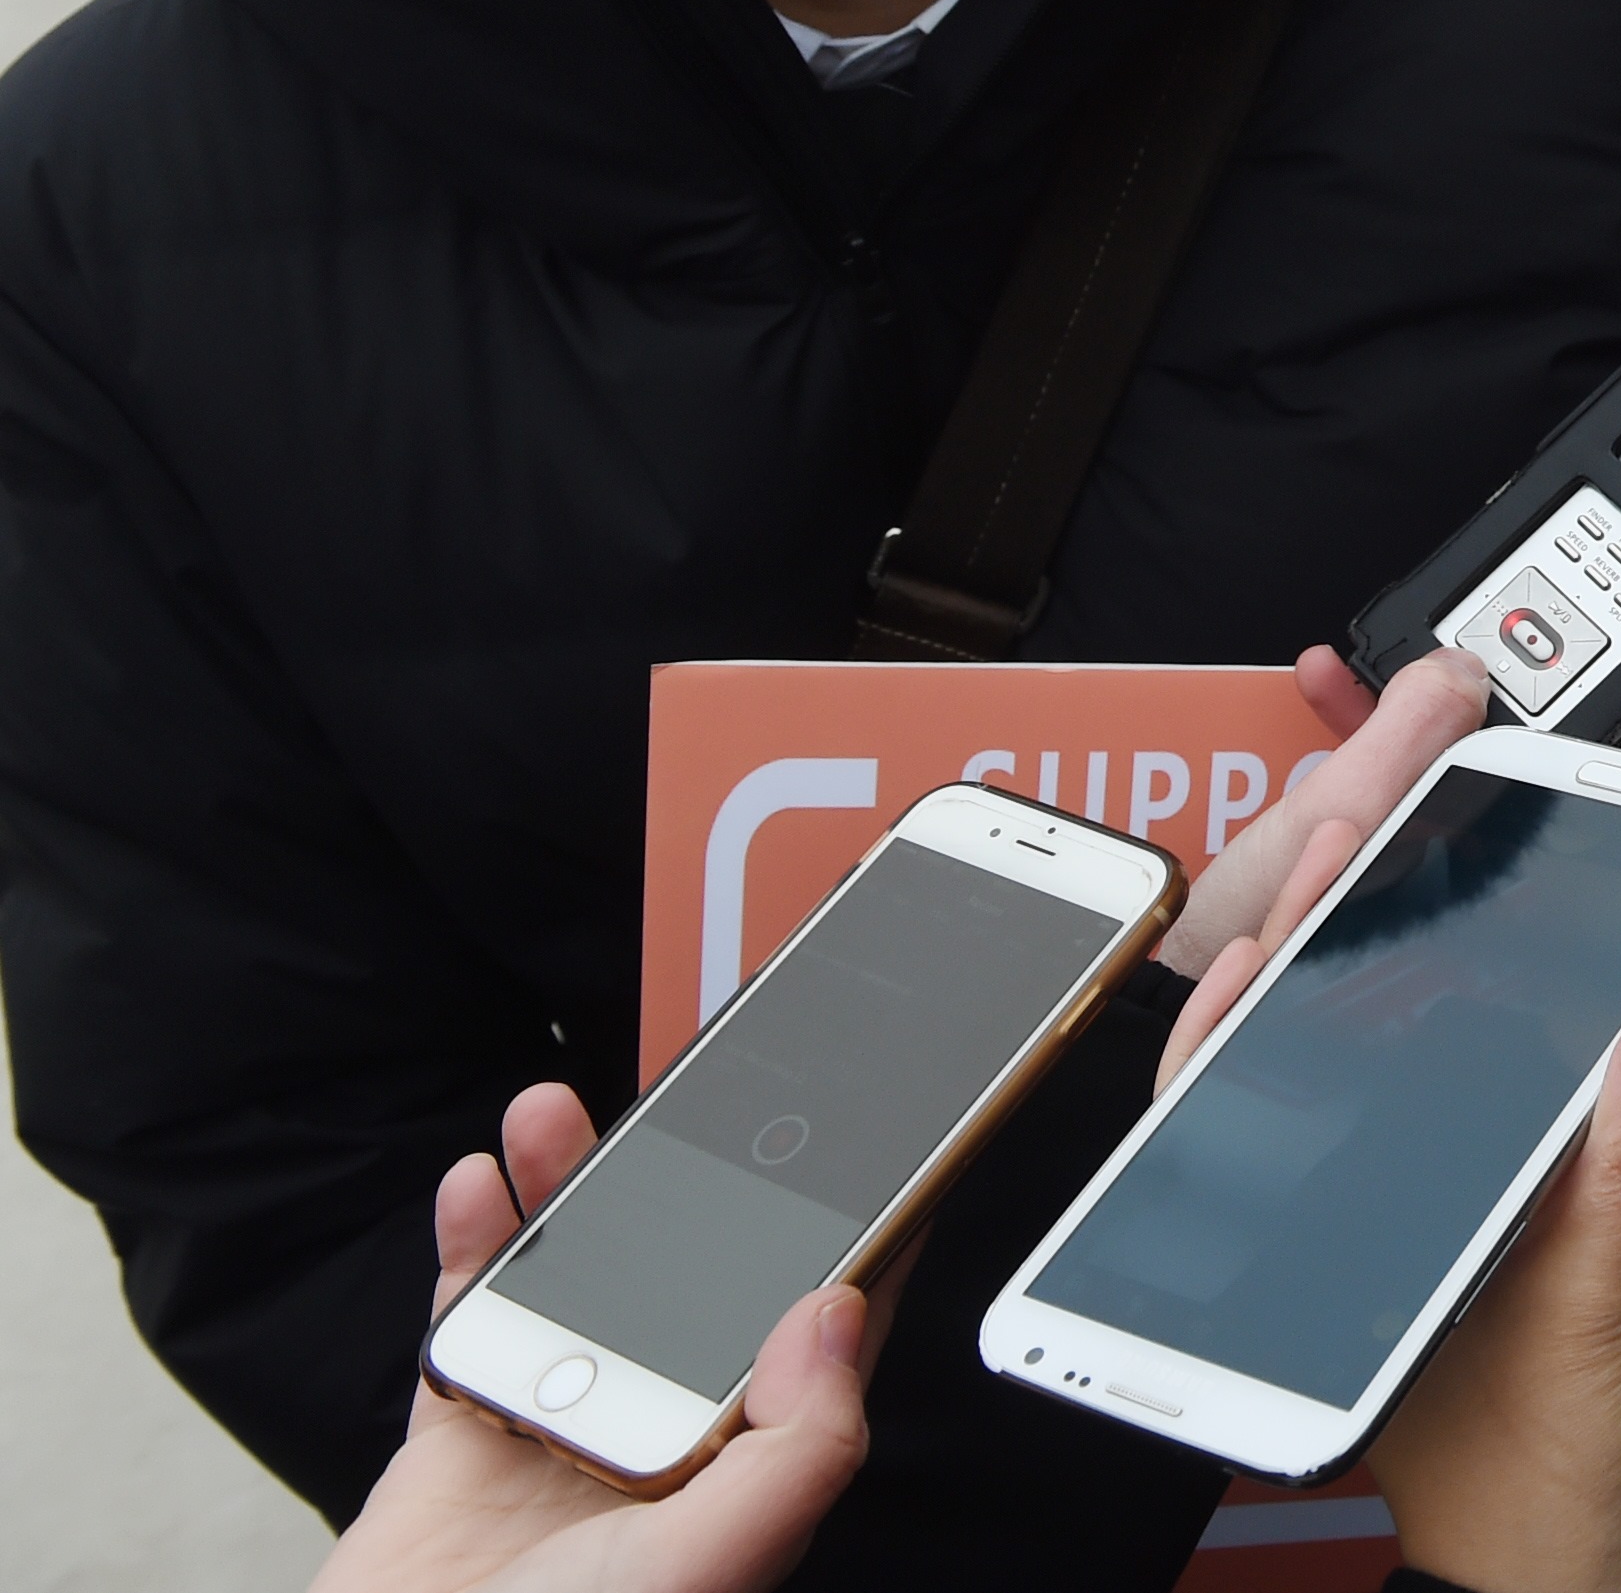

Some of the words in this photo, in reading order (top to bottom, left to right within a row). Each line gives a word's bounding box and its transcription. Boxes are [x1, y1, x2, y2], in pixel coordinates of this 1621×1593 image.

[1587, 508, 1613, 531] FINDER
[1567, 531, 1588, 552] SPEED
[1594, 556, 1620, 582] REVERB
